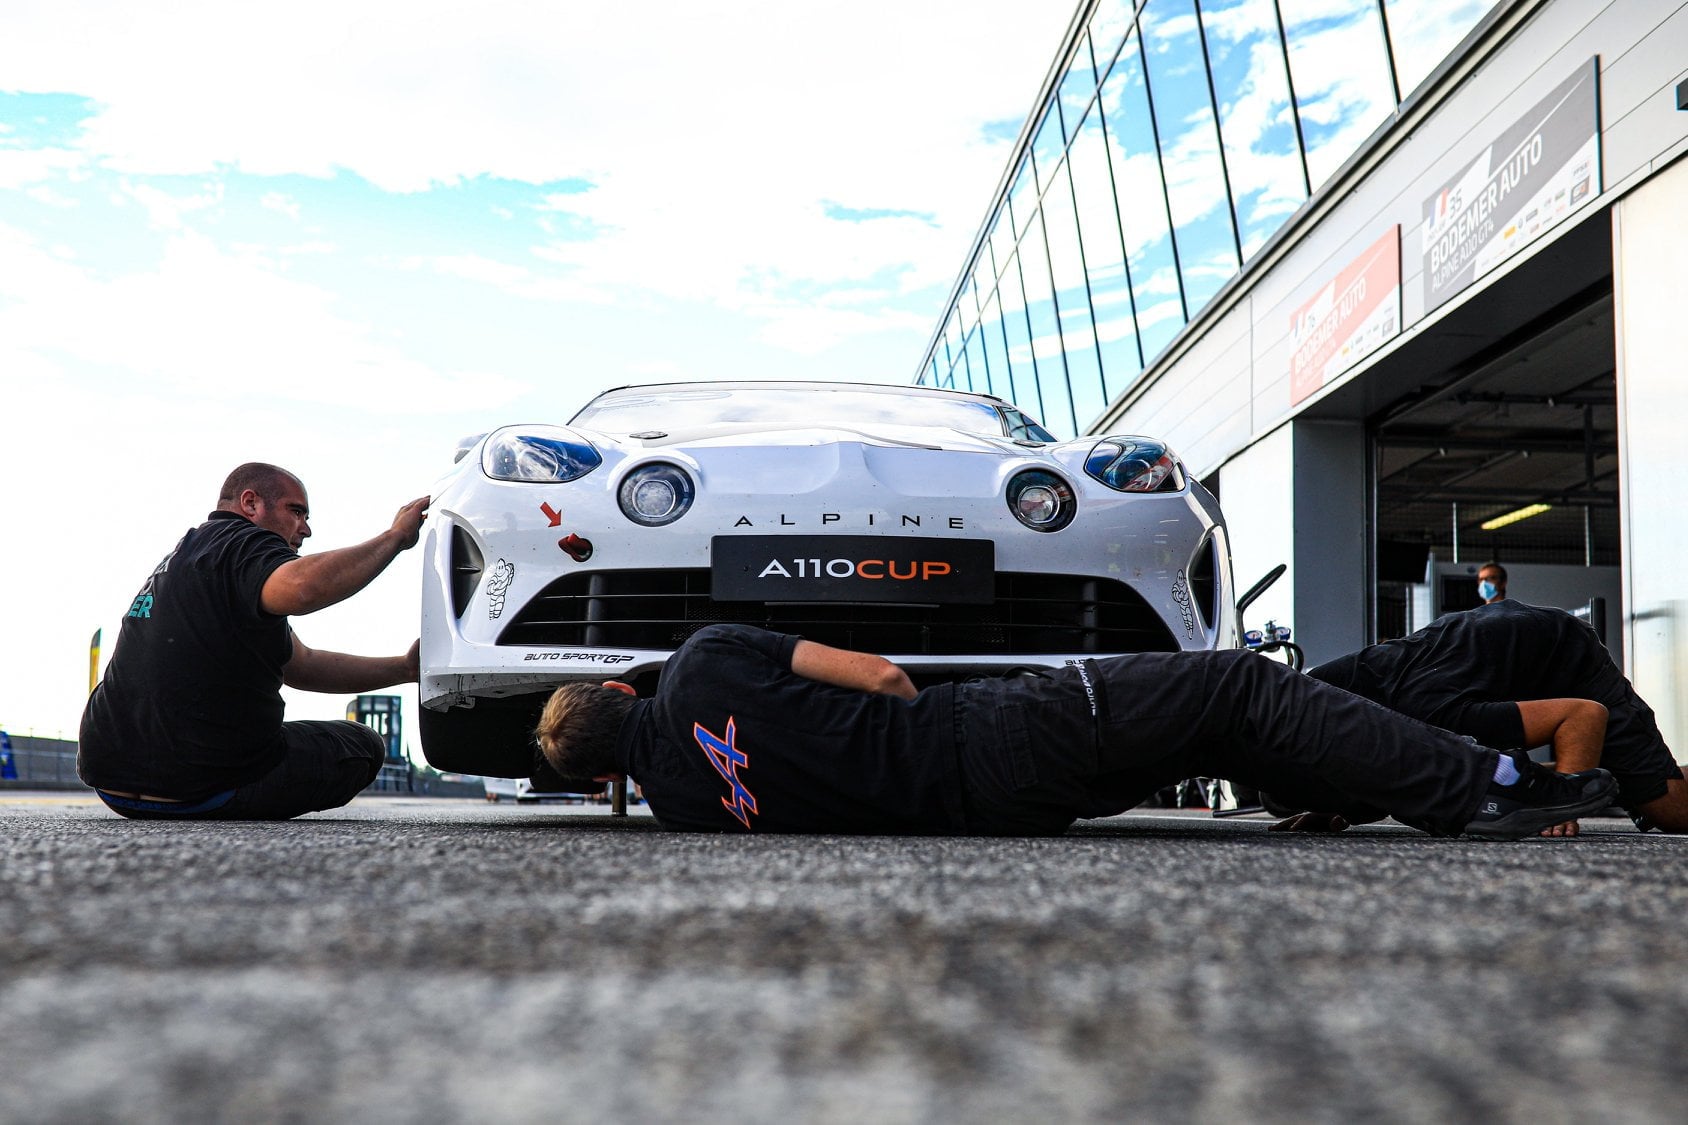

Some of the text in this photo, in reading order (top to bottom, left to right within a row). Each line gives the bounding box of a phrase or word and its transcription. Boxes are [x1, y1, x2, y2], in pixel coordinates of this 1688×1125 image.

[1431, 181, 1498, 274] BODEMER
[1500, 133, 1543, 201] AUTO
[1432, 253, 1459, 290] ALPINE
[1459, 233, 1477, 264] A110
[1478, 218, 1494, 245] GT4
[1341, 276, 1367, 321] AUTO
[733, 513, 965, 530] ALPINE
